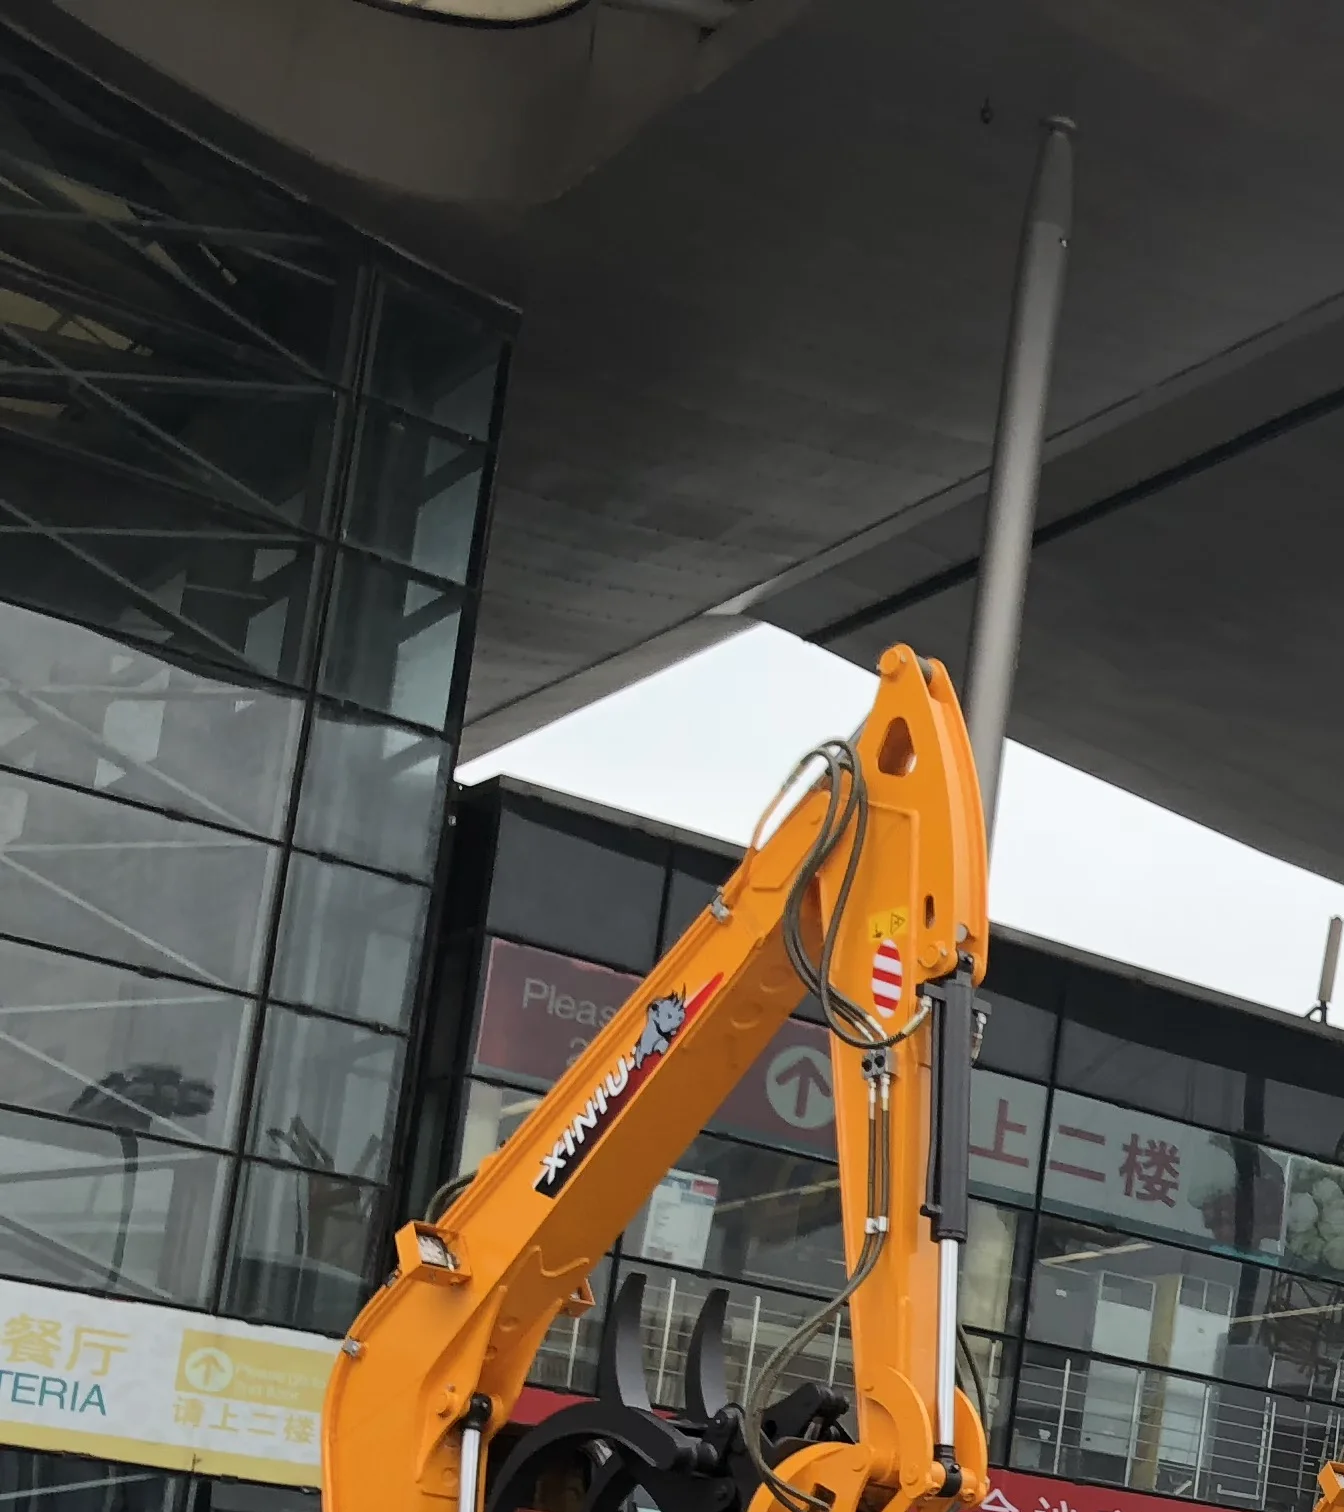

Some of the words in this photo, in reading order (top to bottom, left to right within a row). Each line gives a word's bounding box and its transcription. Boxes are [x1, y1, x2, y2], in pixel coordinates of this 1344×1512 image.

[540, 1052, 632, 1185] XINIU
[969, 1098, 1181, 1208] 上二楼
